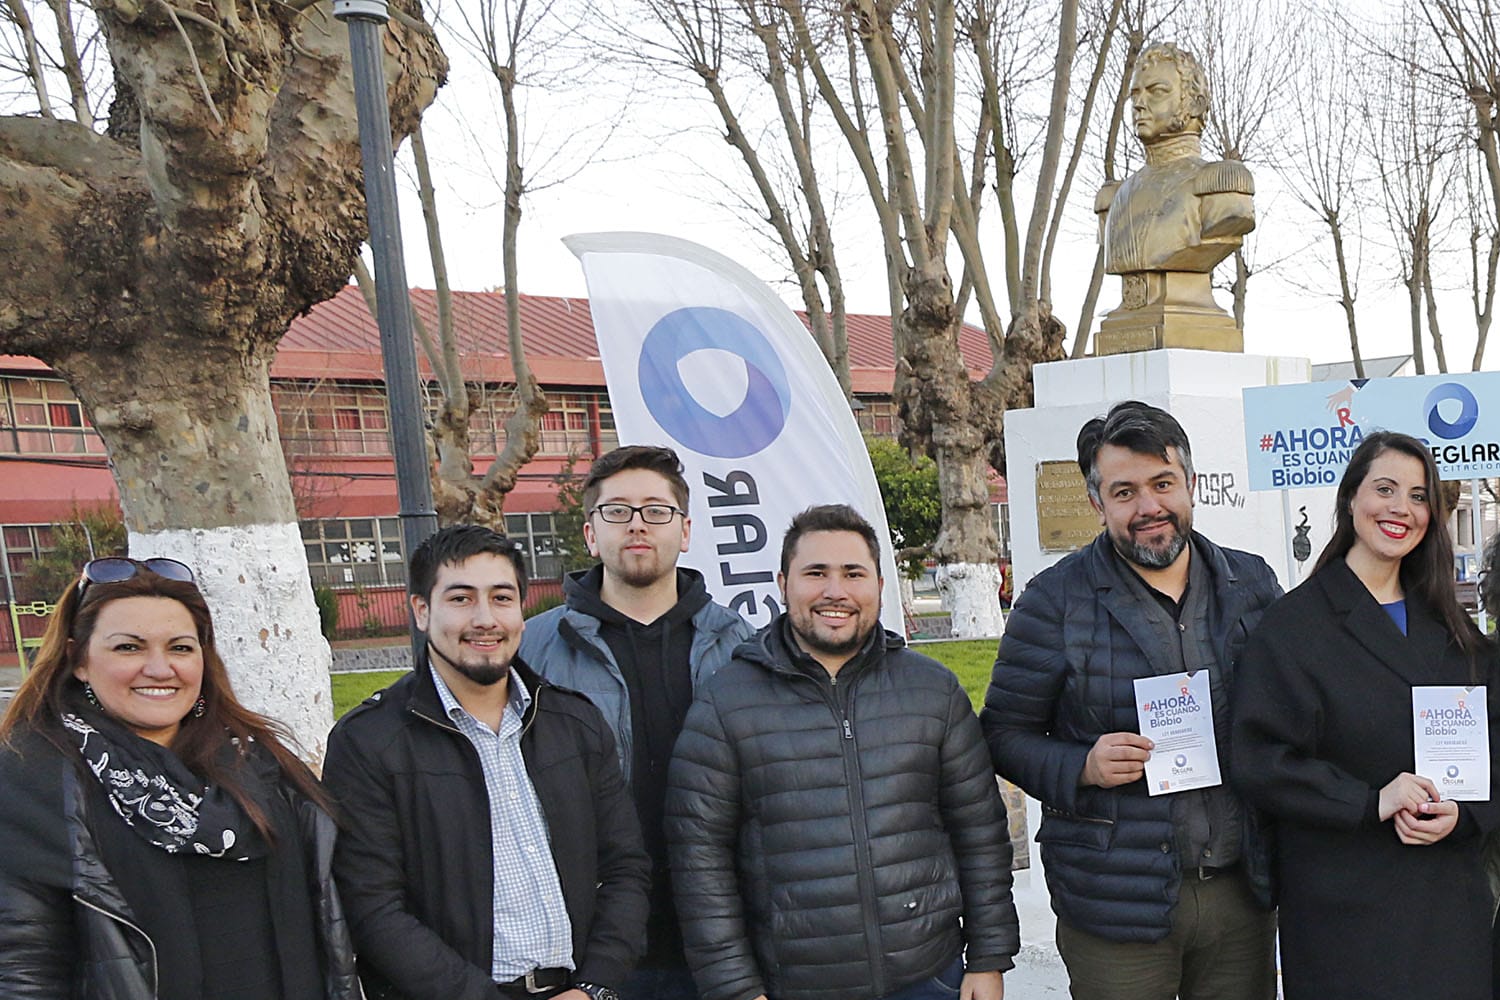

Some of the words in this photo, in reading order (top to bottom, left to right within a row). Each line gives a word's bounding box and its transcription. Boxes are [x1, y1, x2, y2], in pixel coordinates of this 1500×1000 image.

[1337, 407, 1354, 428] R
[1260, 425, 1364, 453] #AHORA
[1282, 454, 1294, 468] ES
[1304, 450, 1352, 466] CUAN
[1417, 438, 1500, 464] EGLAR
[1272, 468, 1336, 487] Biobio
[1143, 695, 1196, 712] #AHORA
[1166, 705, 1200, 717] CUANDO
[1420, 709, 1473, 719] #AHORA
